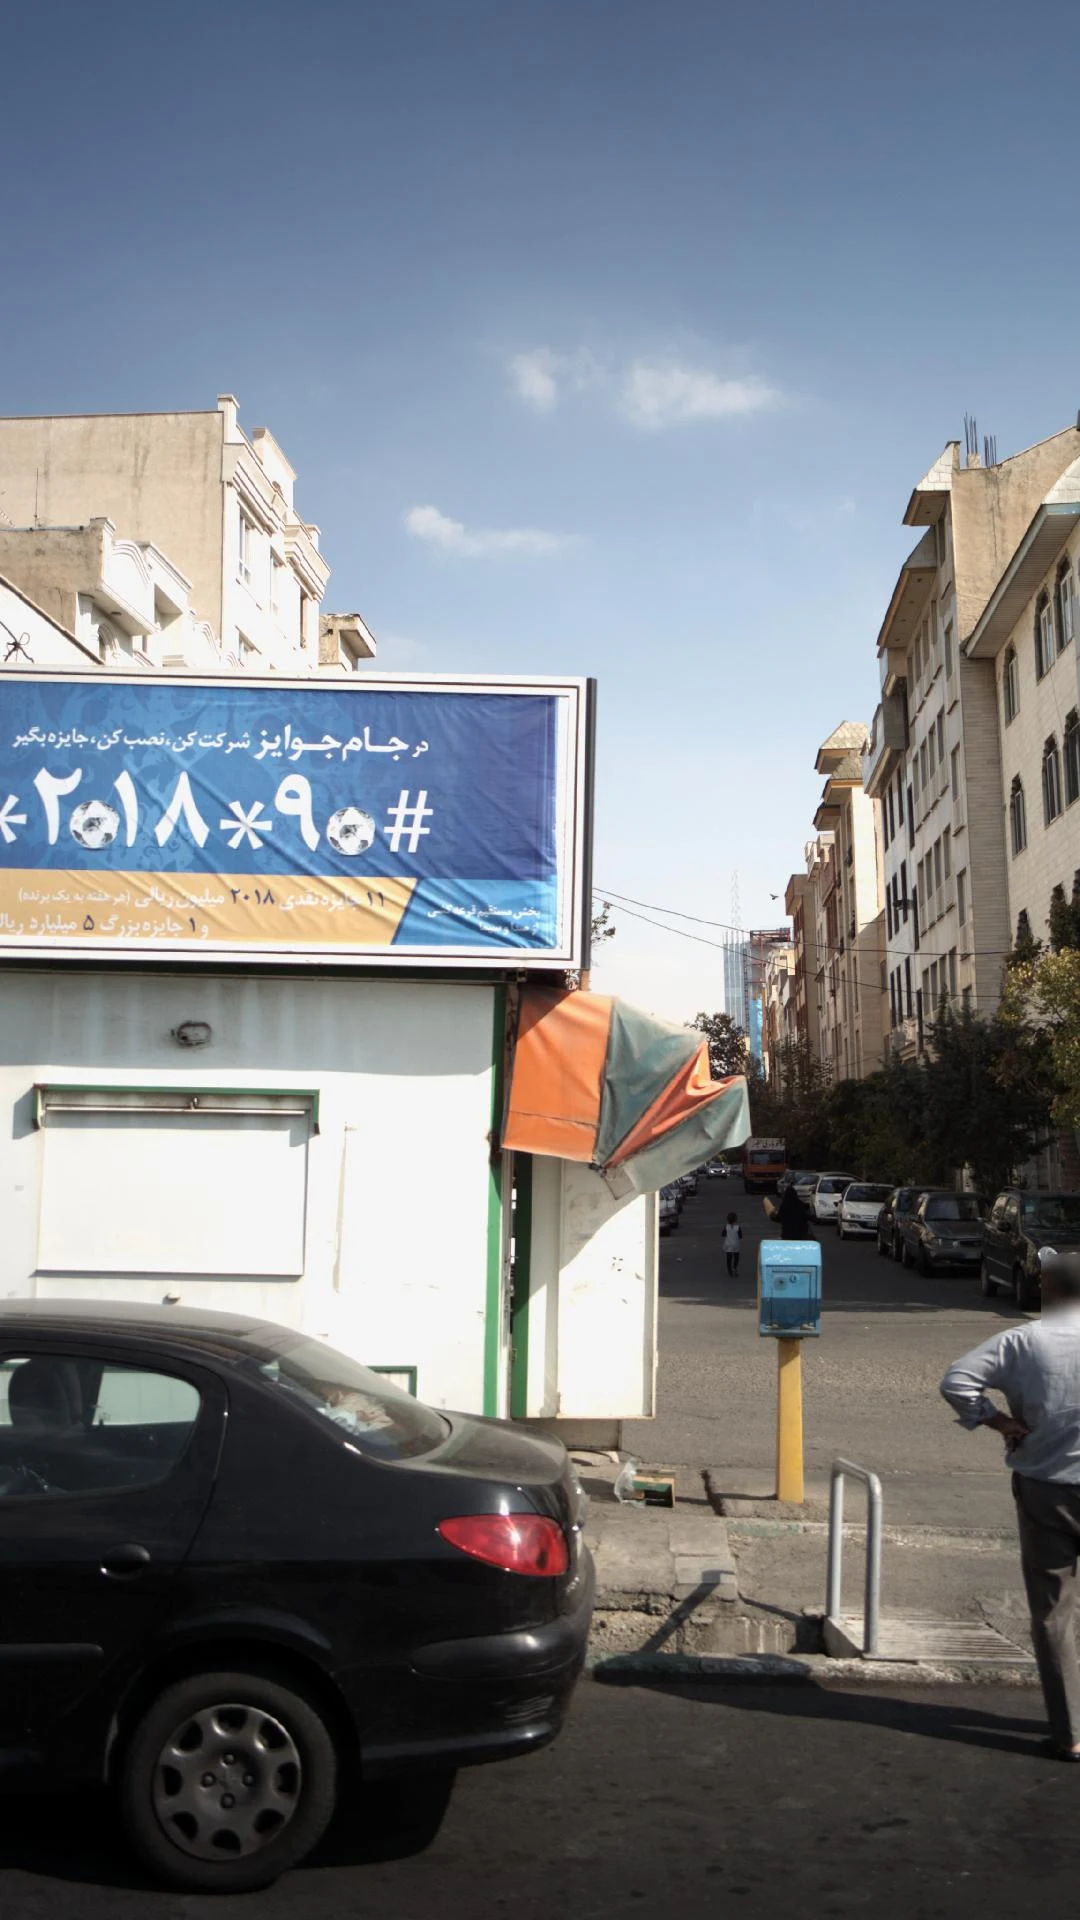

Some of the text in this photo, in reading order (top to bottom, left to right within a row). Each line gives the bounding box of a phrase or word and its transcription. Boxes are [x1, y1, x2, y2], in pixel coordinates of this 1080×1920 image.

[12, 726, 47, 747] بگیر
[47, 728, 89, 748] جایزه
[123, 731, 166, 750] نصب
[199, 731, 251, 754] شرکت
[253, 723, 343, 761] جوایز
[341, 726, 410, 762] جام
[412, 738, 429, 758] در
[229, 888, 275, 905] ۲۰۱۸
[29, 913, 78, 936] میلیارد
[83, 914, 95, 931] ۵
[189, 917, 196, 933] ۱
[200, 924, 210, 939] و
